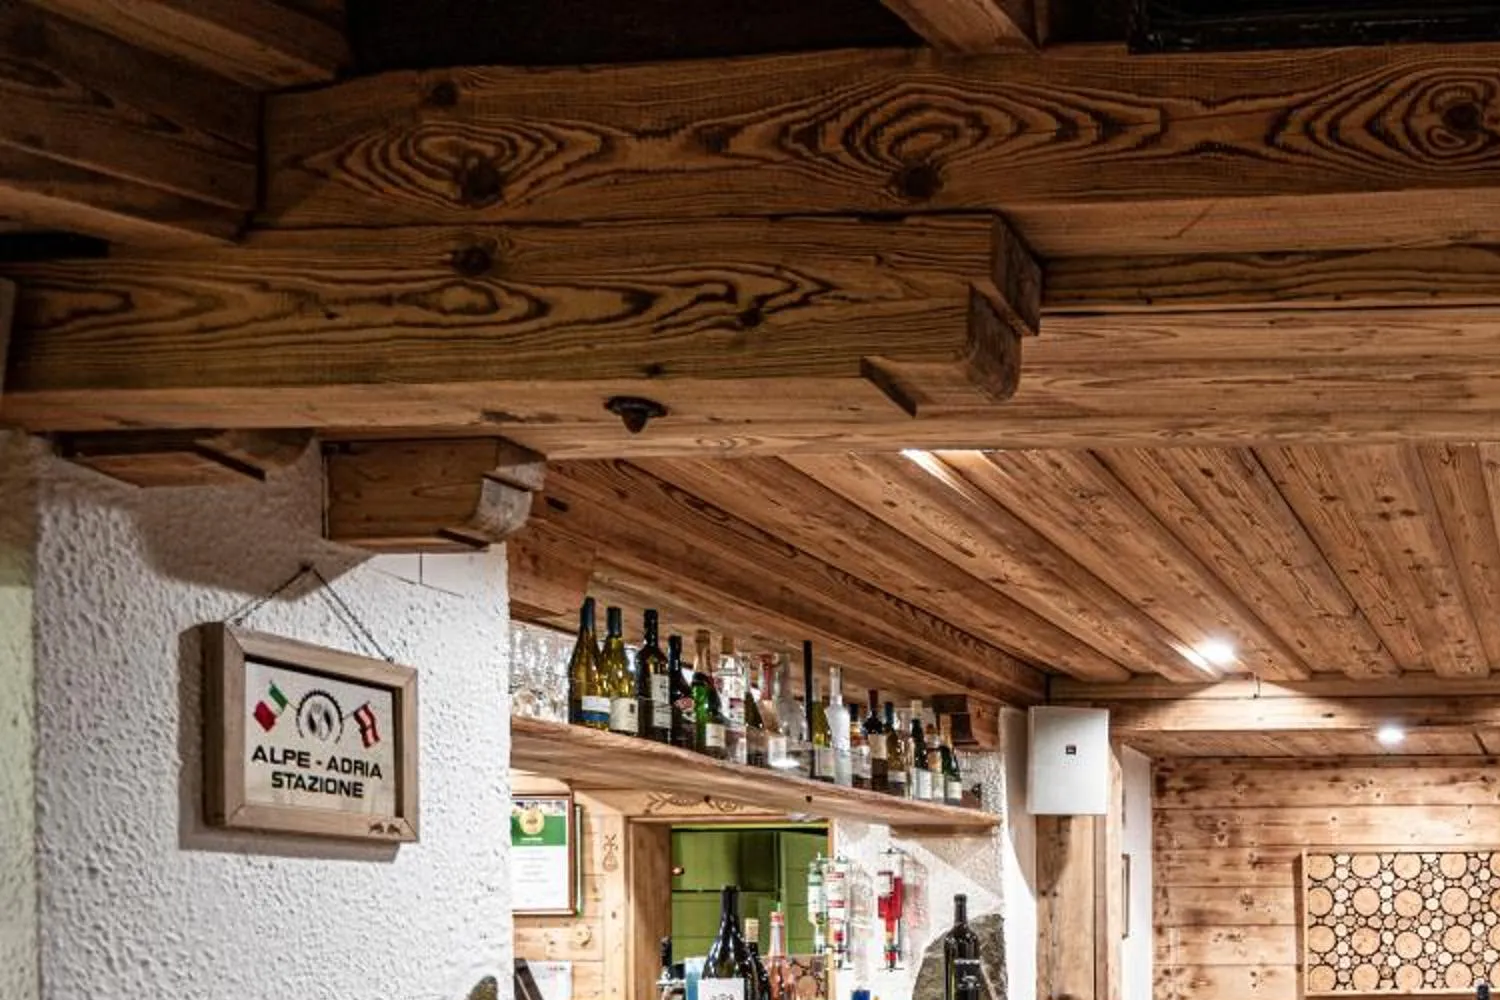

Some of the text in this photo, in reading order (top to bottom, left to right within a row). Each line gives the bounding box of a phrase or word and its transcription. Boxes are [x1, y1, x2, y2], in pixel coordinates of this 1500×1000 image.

[252, 744, 311, 769] ALPE
[326, 755, 383, 780] ADRIA
[271, 771, 364, 799] STAZIONE
